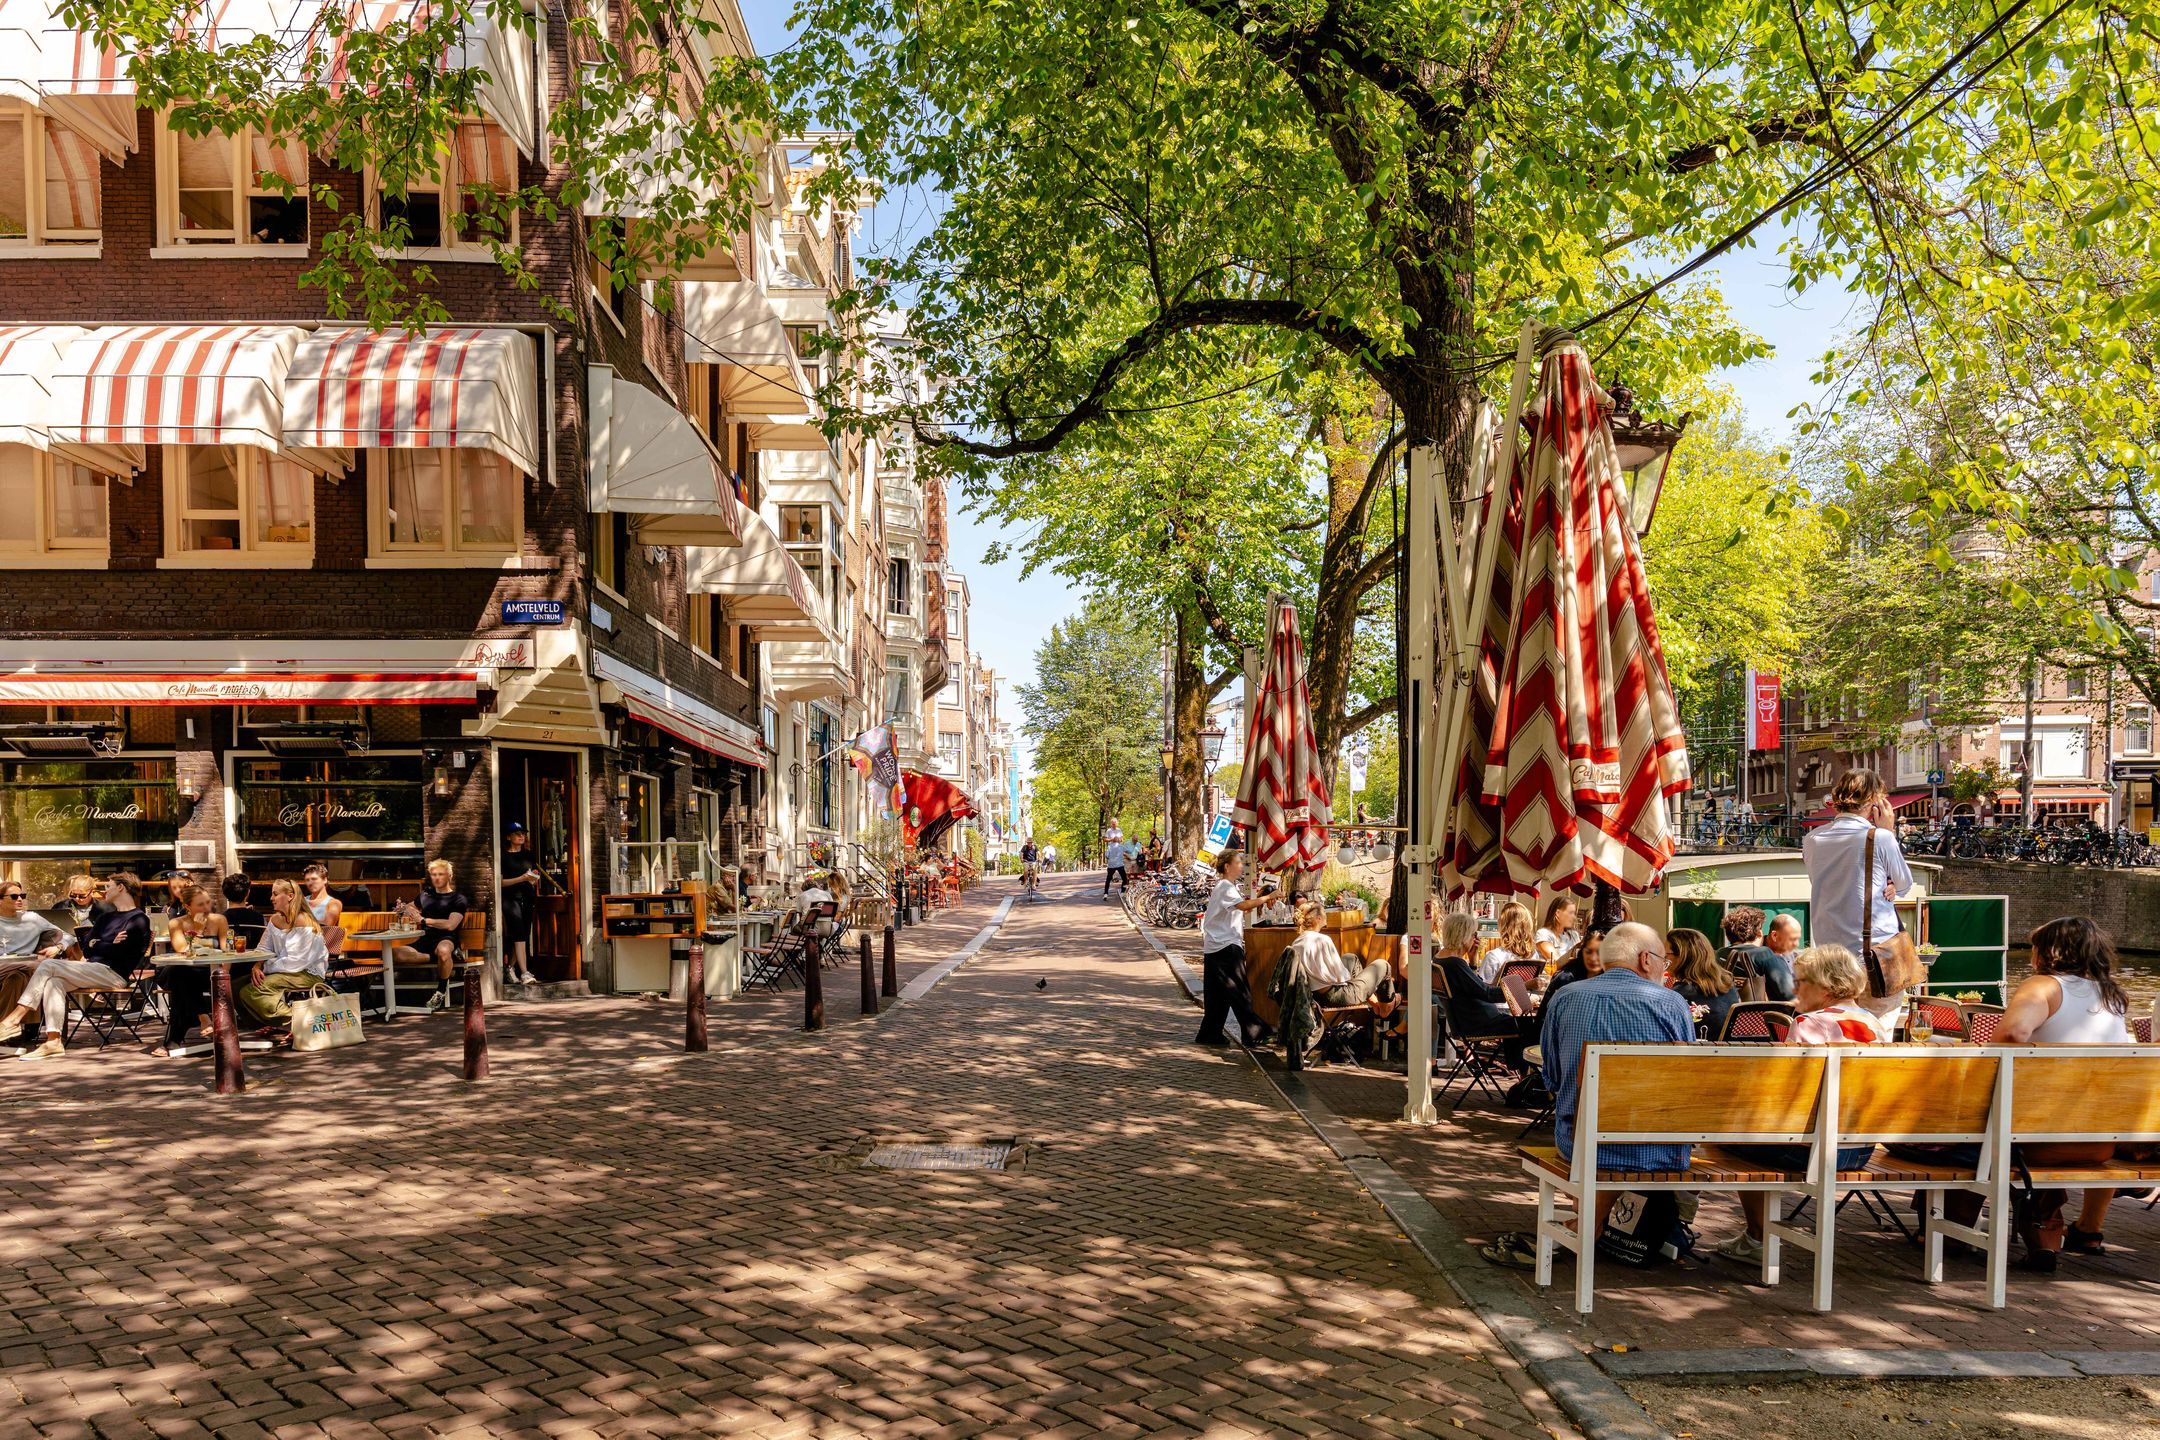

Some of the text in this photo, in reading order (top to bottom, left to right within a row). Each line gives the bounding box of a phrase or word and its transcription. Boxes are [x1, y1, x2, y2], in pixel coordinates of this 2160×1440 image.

[506, 603, 560, 613] AMSTELVELD
[532, 613, 560, 621] CENTRUM
[475, 643, 527, 663] Duvel
[542, 730, 554, 740] 21
[880, 756, 895, 782] PRIDE
[74, 803, 139, 820] Marcella
[318, 802, 382, 818] Marcella
[1216, 818, 1230, 832] P
[312, 1018, 357, 1034] ANTWERP
